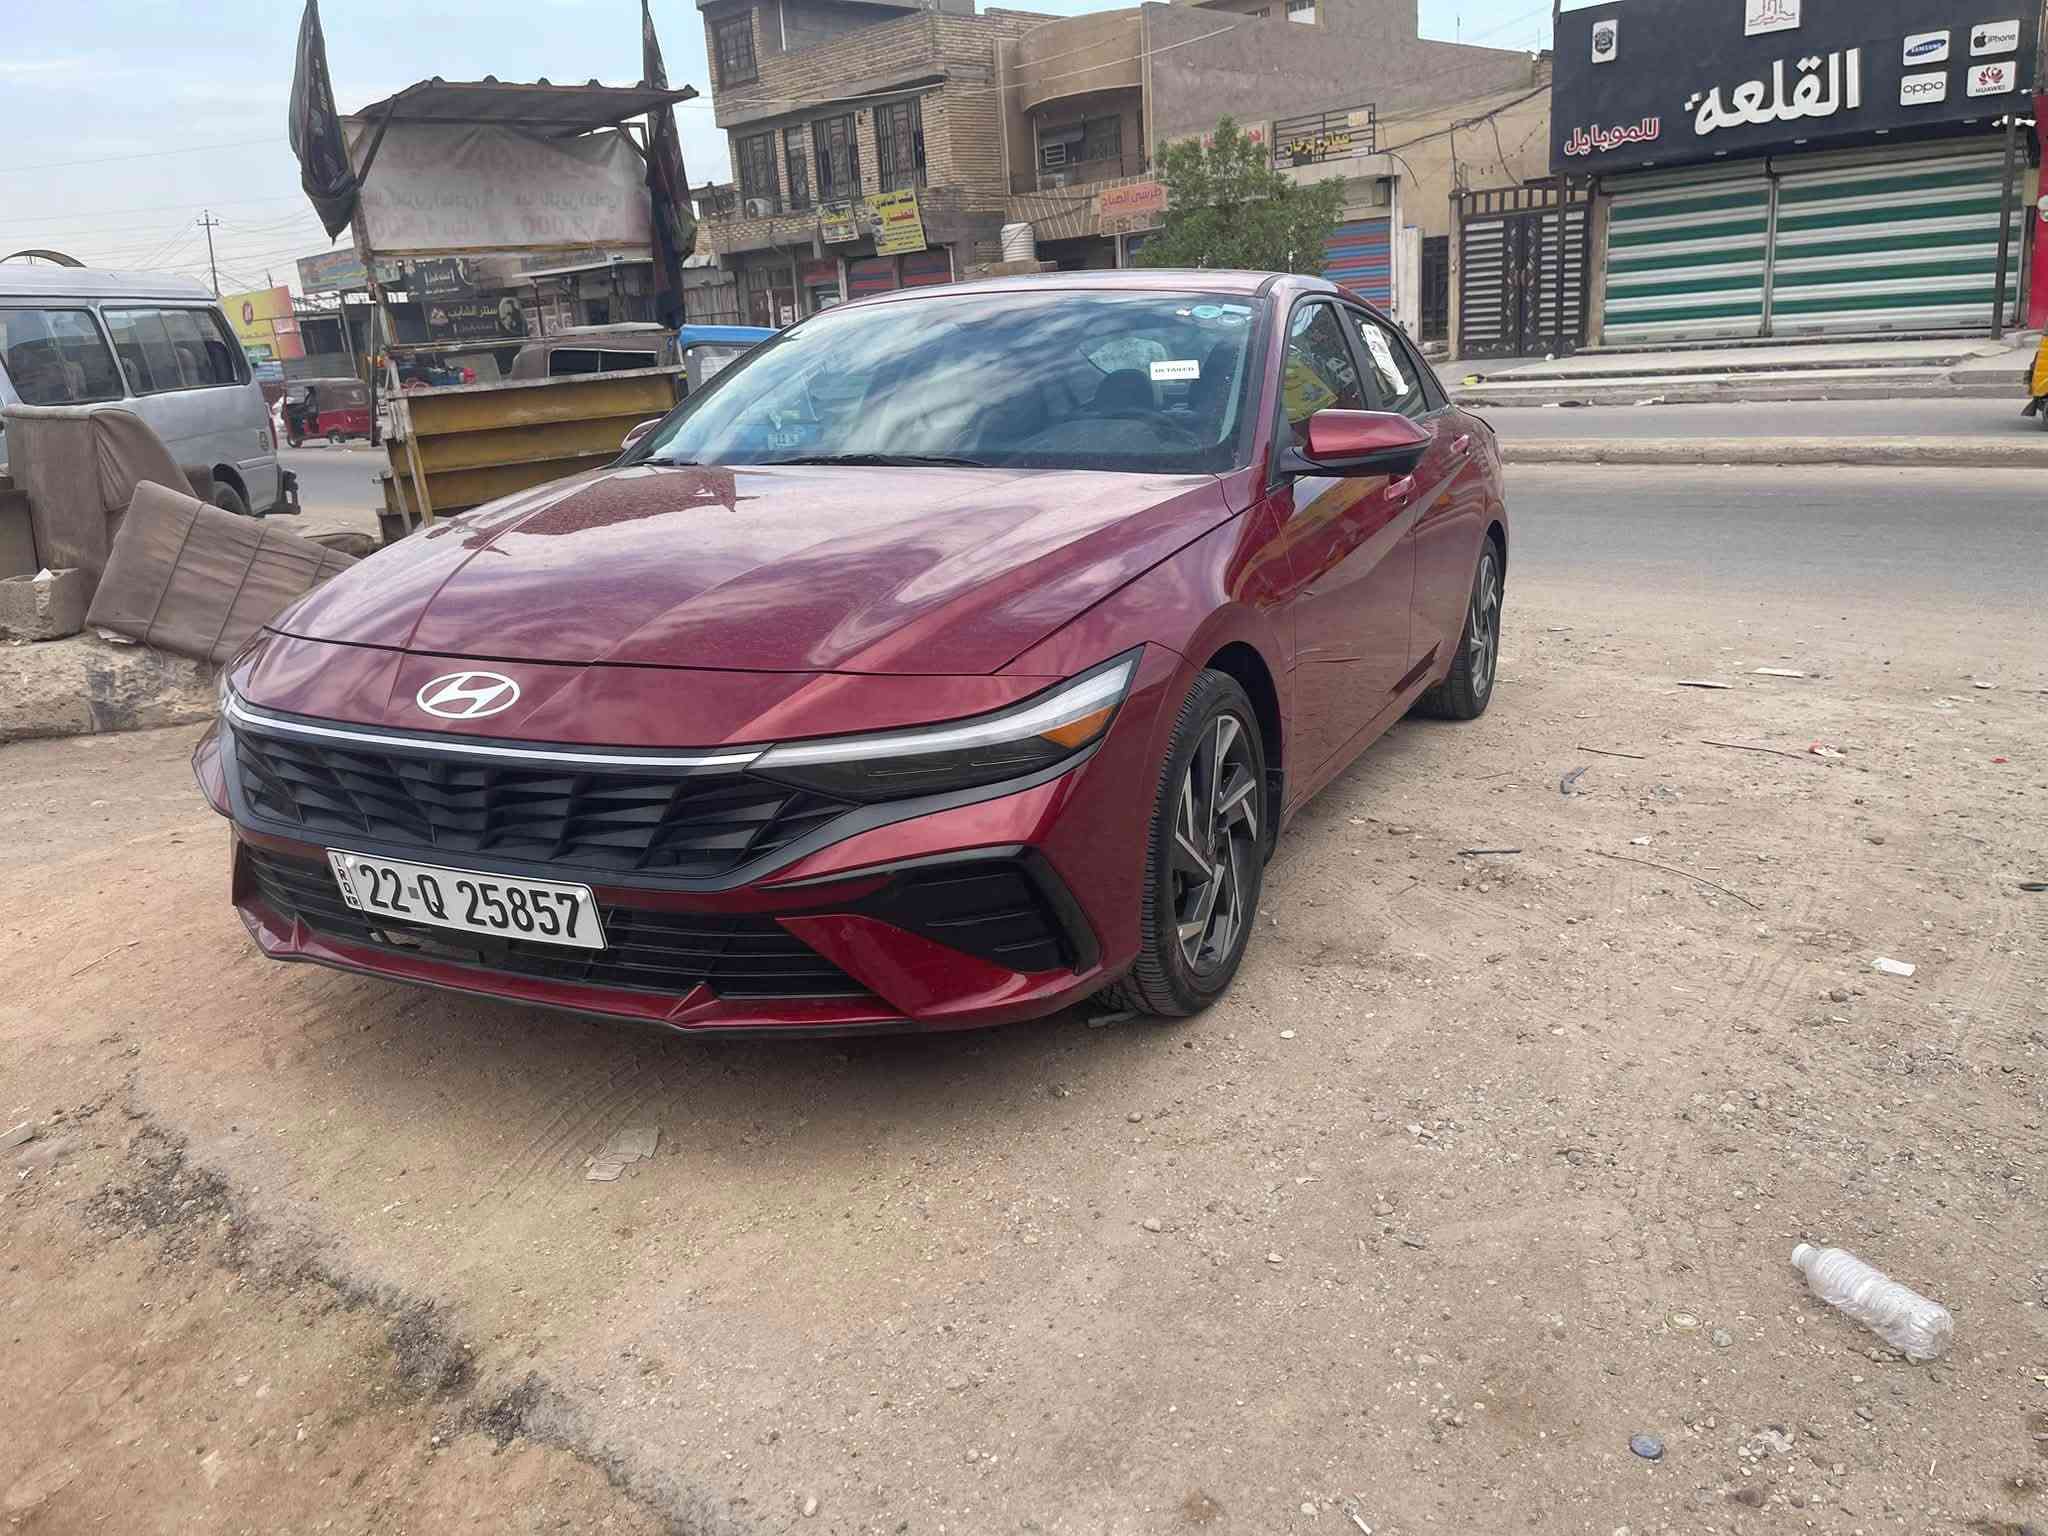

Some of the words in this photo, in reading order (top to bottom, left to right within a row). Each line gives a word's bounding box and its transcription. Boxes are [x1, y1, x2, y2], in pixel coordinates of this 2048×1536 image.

[1684, 48, 1860, 135] القلعة
[1975, 85, 2006, 94] HUAWEI
[1563, 117, 1660, 156] للموبايل
[417, 873, 449, 920] Q
[456, 880, 579, 938] 25857
